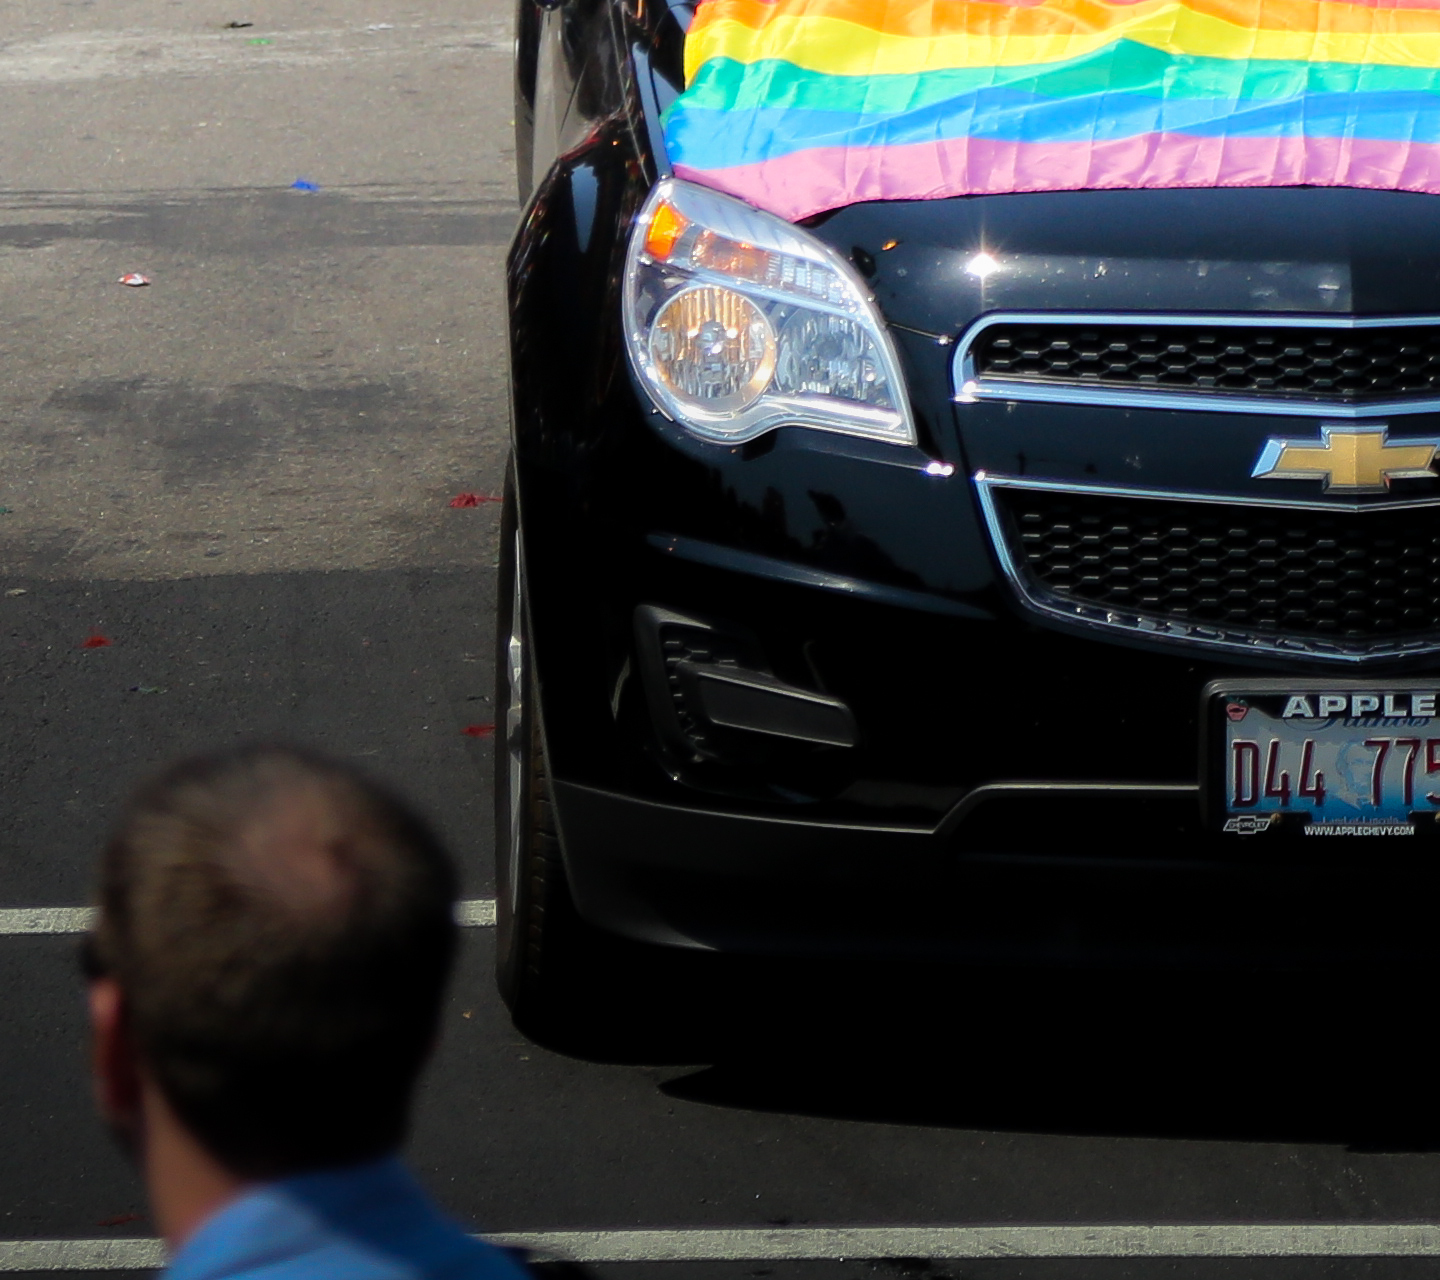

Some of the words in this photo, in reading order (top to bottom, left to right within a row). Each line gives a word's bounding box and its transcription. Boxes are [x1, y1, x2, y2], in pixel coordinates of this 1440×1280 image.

[1282, 694, 1437, 718] APPLE
[1231, 739, 1326, 807] D44
[1304, 825, 1415, 837] WWW.APPLECHEVY.COM
